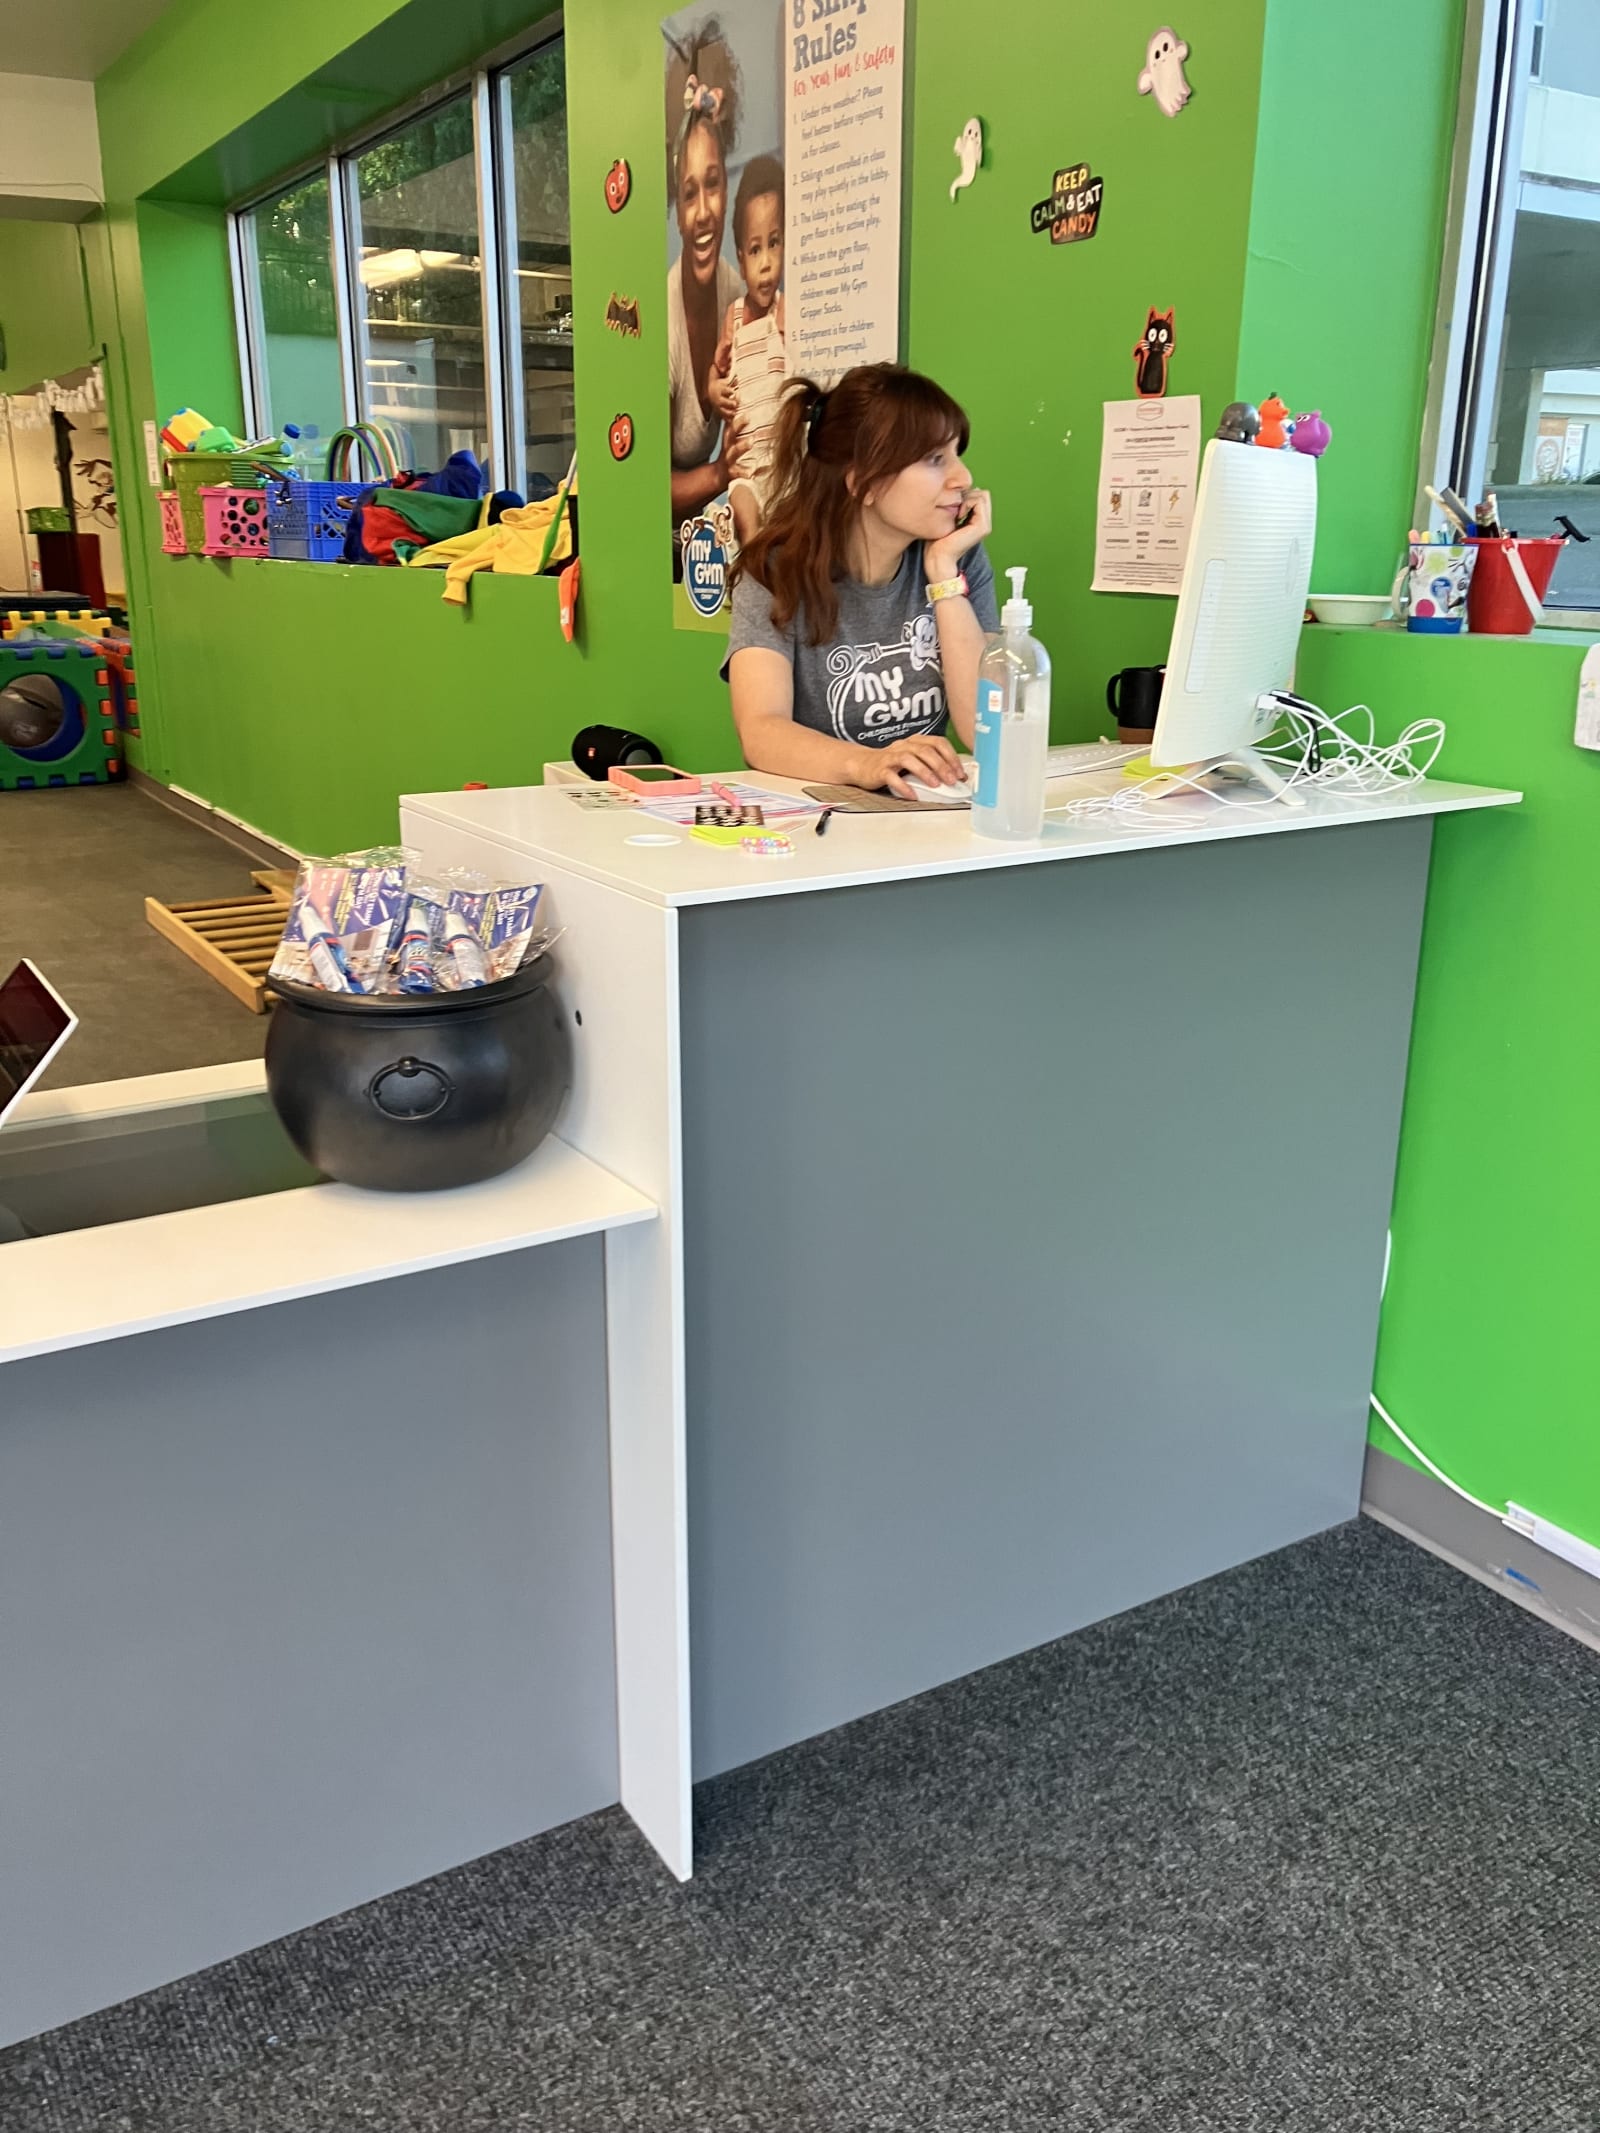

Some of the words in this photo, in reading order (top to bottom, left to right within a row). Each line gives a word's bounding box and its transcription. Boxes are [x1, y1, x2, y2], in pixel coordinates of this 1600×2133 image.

[793, 0, 805, 29] 8
[793, 22, 857, 72] Rules
[863, 44, 896, 70] Safety
[820, 103, 831, 114] the
[863, 86, 883, 100] Please
[833, 115, 853, 130] before
[823, 165, 835, 175] not
[836, 155, 861, 172] enrolled
[870, 147, 886, 161] class
[814, 186, 827, 201] play
[828, 177, 849, 196] quietly
[858, 172, 869, 185] the
[1055, 168, 1088, 192] KEEP
[800, 212, 811, 224] The
[812, 208, 828, 222] lobby
[836, 202, 845, 214] for
[869, 193, 881, 206] the
[1033, 196, 1065, 228] CALM
[1066, 194, 1075, 211] &
[1076, 184, 1102, 212] EAT
[800, 233, 814, 247] gym
[815, 227, 829, 239] floor
[836, 221, 845, 233] for
[846, 217, 865, 231] active
[1052, 211, 1096, 240] CANDY
[800, 251, 817, 264] While
[818, 252, 826, 261] on
[827, 247, 838, 259] the
[838, 246, 853, 261] gym
[800, 270, 818, 283] adults
[819, 269, 833, 278] wear
[834, 262, 851, 276] socks
[851, 258, 864, 273] and
[800, 287, 823, 301] children
[825, 286, 840, 296] wear
[840, 281, 851, 296] My
[851, 278, 868, 294] Gym
[799, 328, 832, 344] Equipment
[838, 322, 848, 334] for
[848, 320, 875, 334] children
[691, 540, 711, 561] MY
[694, 563, 724, 585] GYM
[854, 666, 904, 703] MY
[864, 686, 942, 727] GYM
